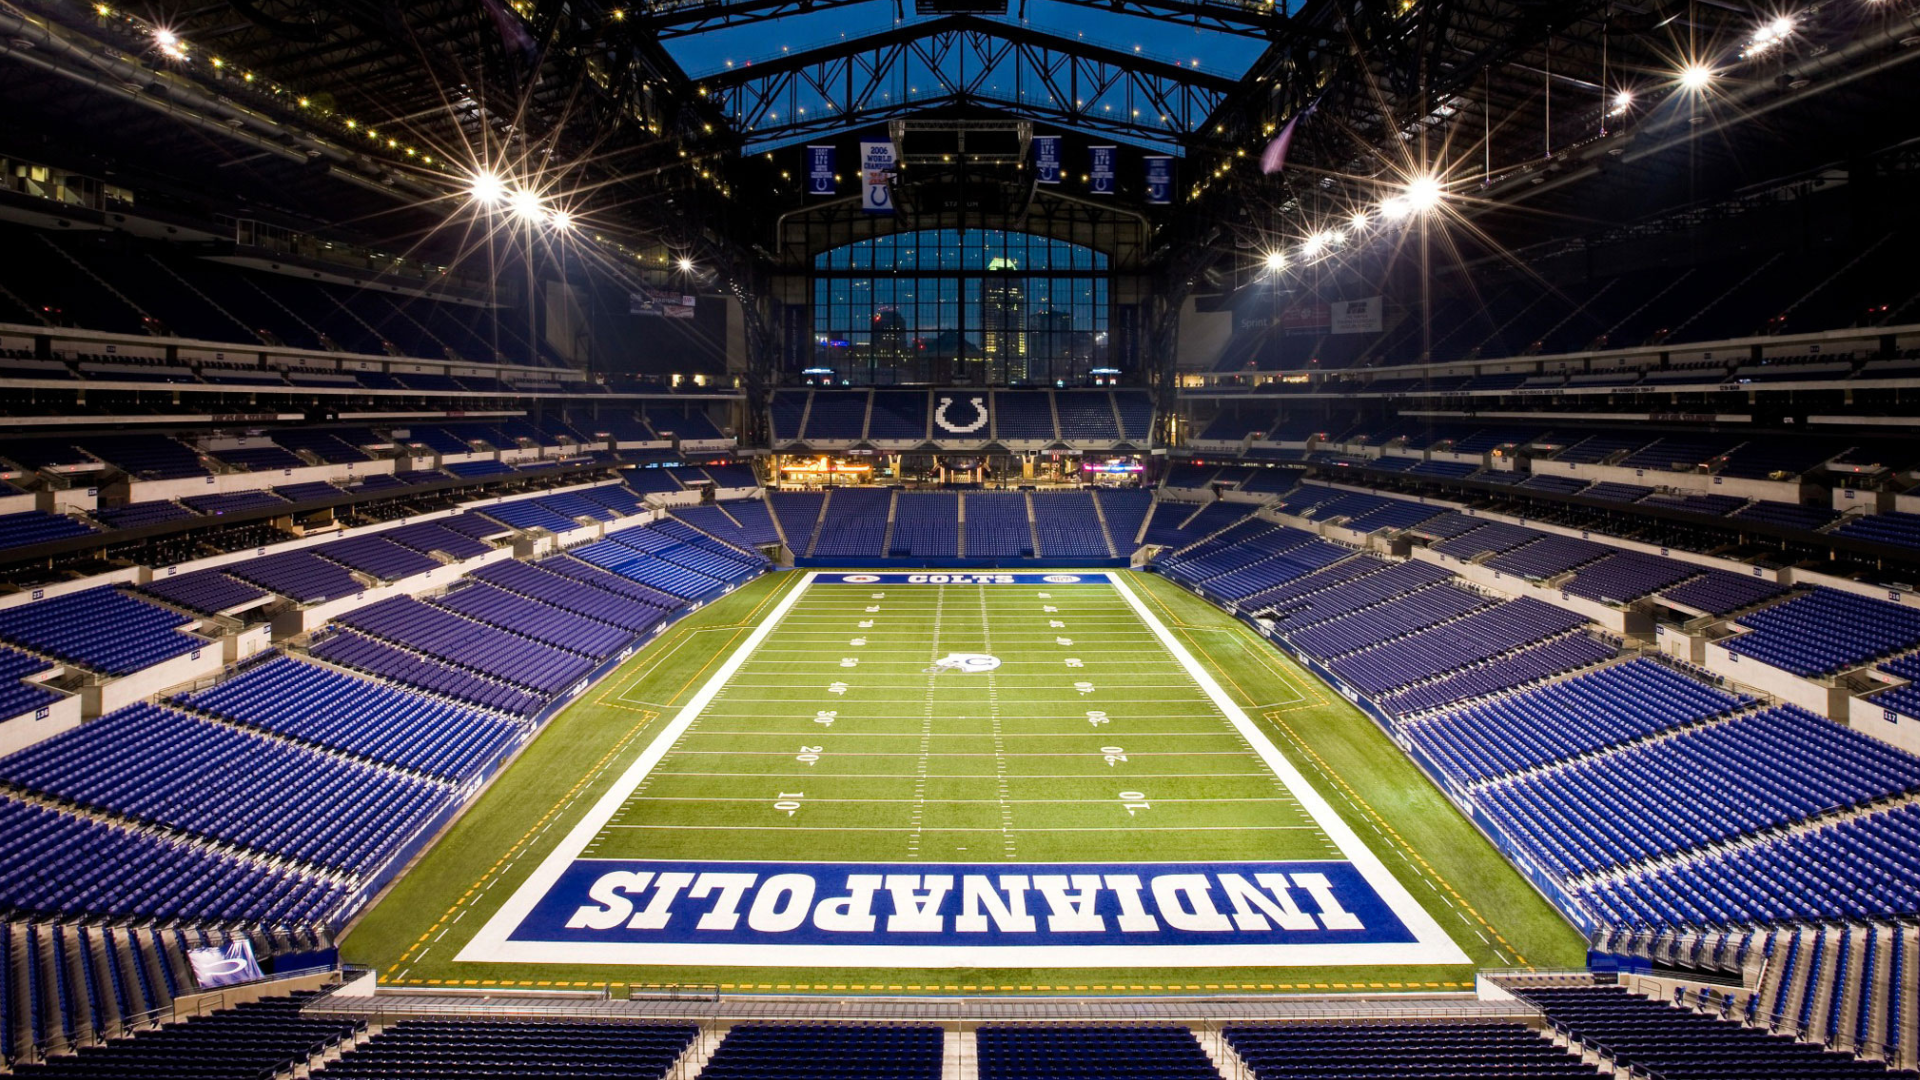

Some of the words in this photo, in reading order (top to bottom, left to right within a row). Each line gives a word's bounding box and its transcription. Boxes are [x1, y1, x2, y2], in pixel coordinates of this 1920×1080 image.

[1241, 317, 1268, 329] Sprint
[908, 575, 1015, 584] COLTS
[813, 710, 838, 723] 30
[796, 746, 823, 761] 20
[1100, 746, 1128, 762] 20
[774, 791, 804, 810] 10
[1118, 791, 1151, 809] 10
[564, 870, 1366, 933] INDIANAPOLIS
